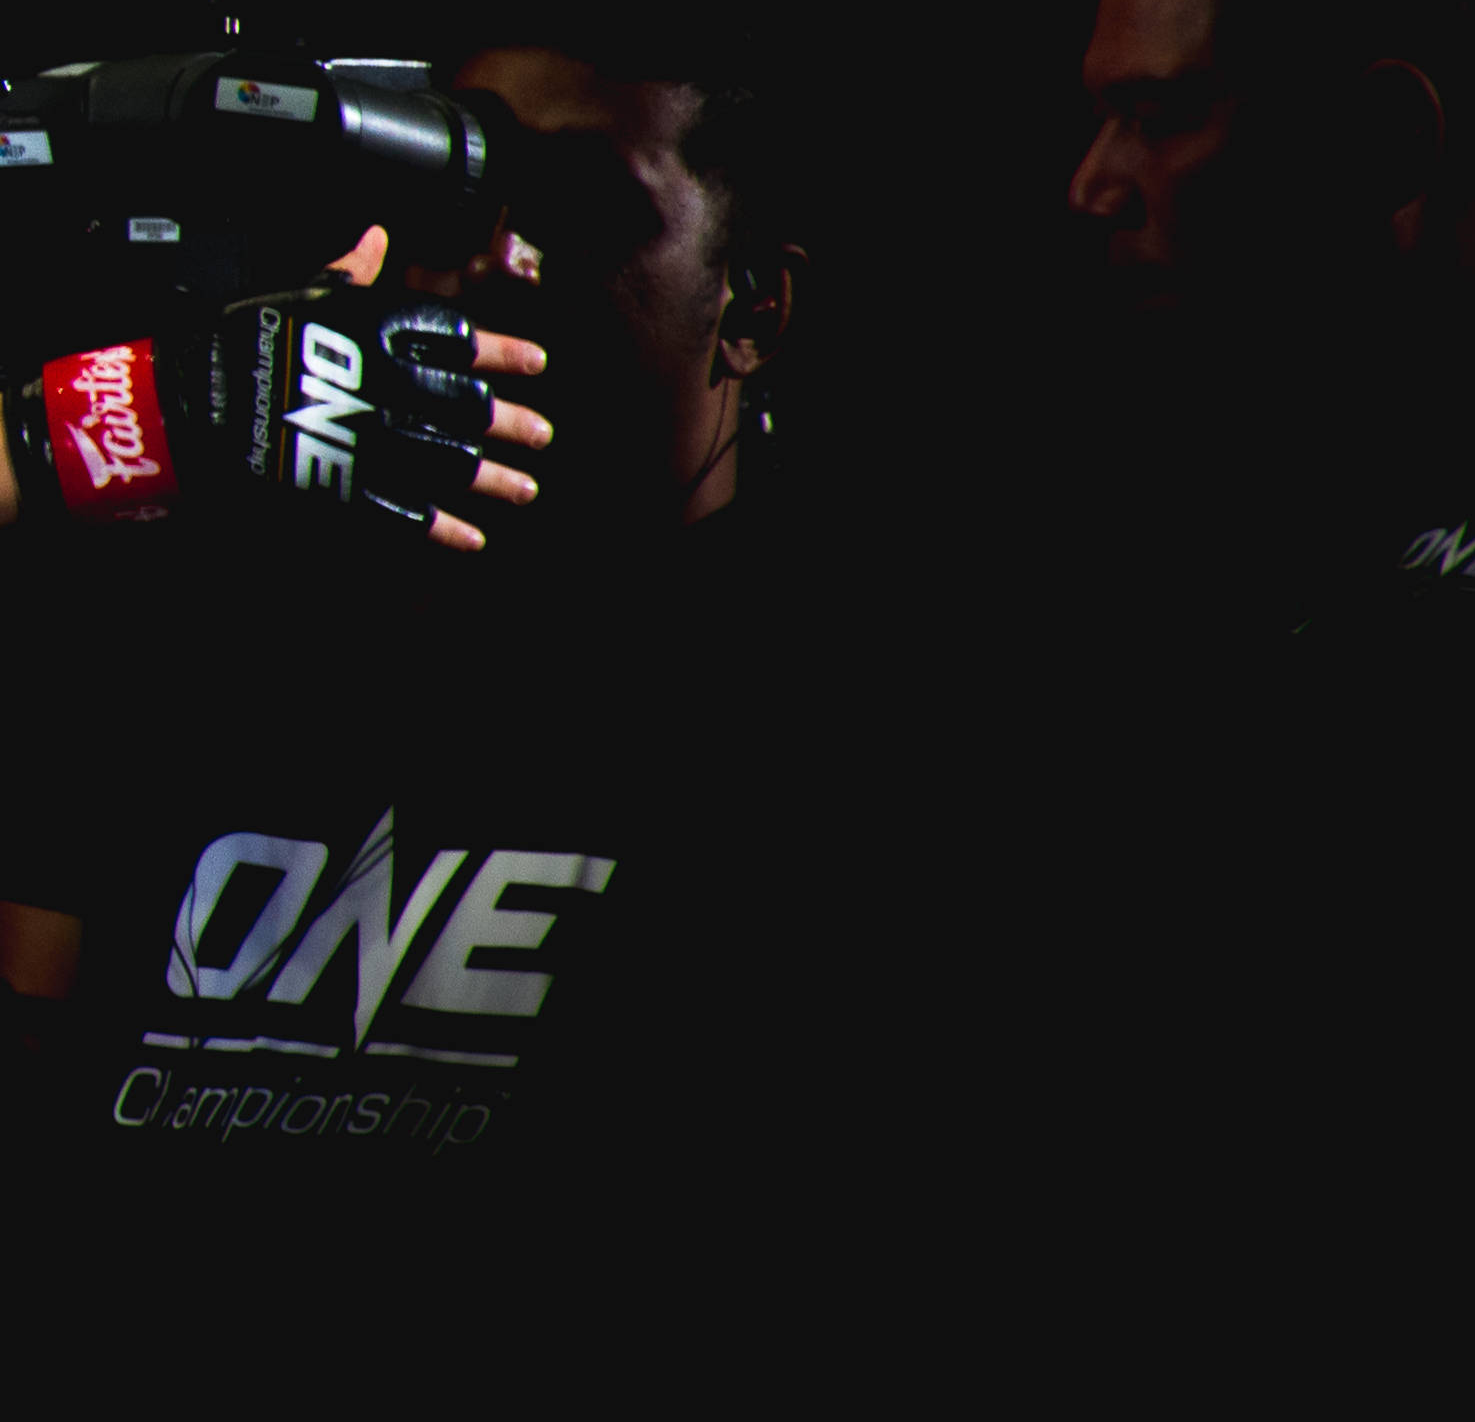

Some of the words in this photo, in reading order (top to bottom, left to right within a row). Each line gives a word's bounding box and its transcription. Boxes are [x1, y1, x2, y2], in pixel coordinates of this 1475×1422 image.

[66, 345, 162, 490] Fairtex
[246, 307, 281, 475] Championship
[282, 322, 376, 504] ONE
[1396, 518, 1475, 578] ON
[166, 804, 619, 1054] ONE
